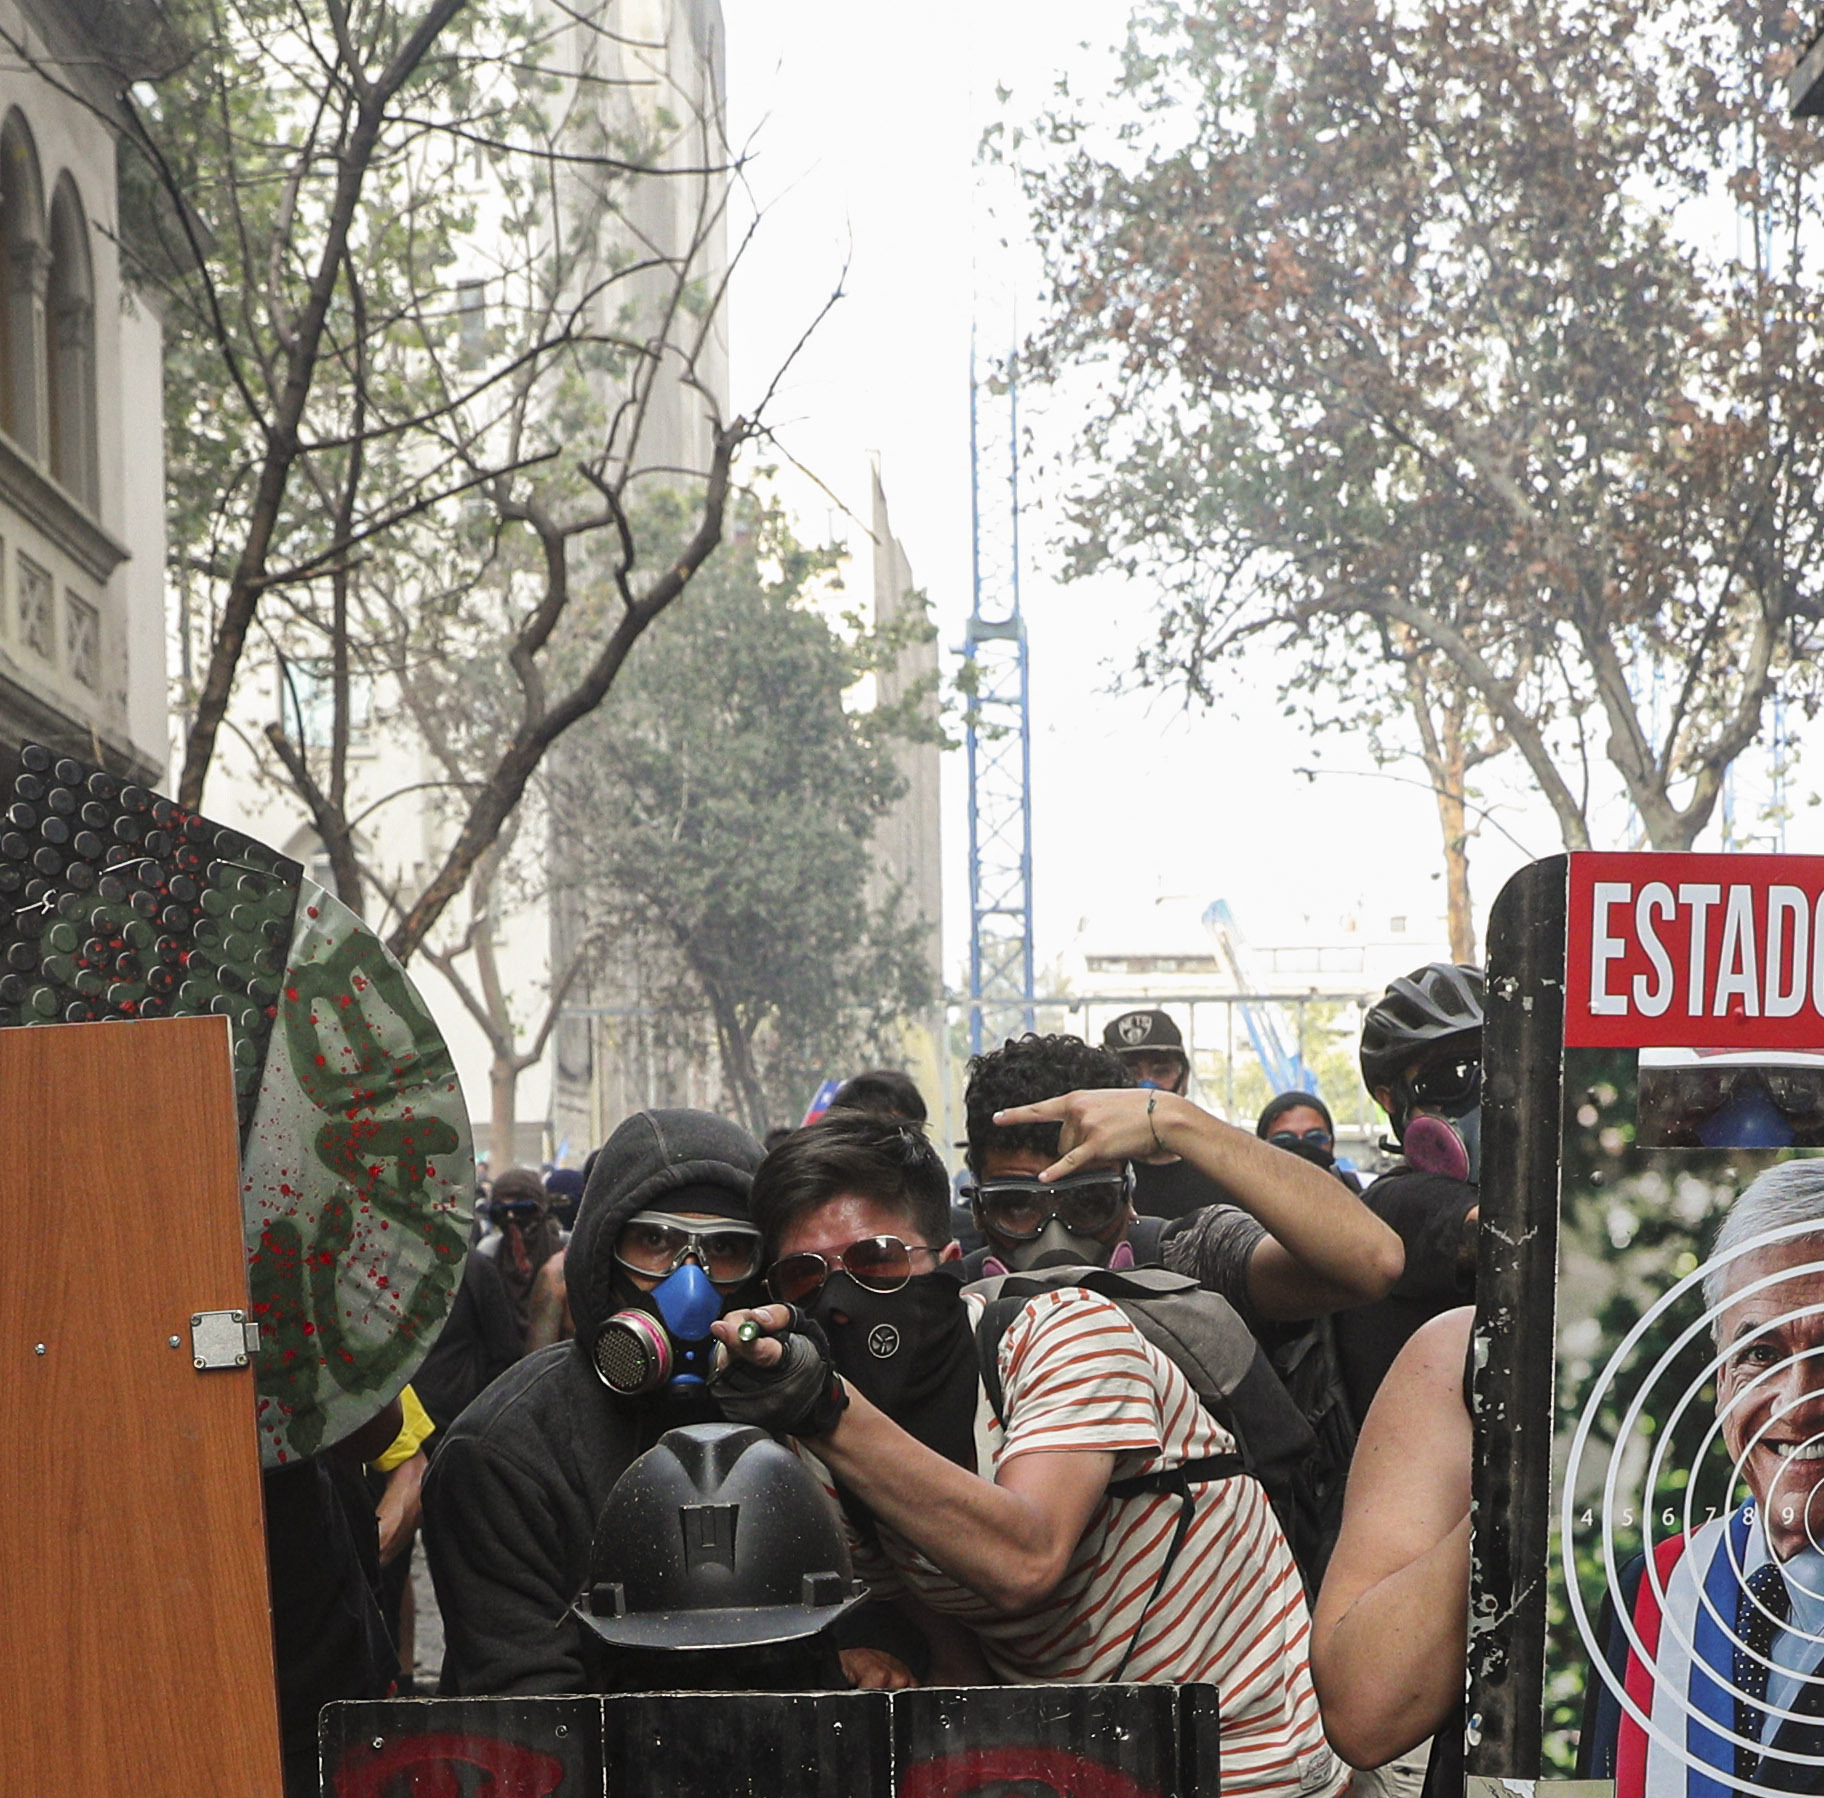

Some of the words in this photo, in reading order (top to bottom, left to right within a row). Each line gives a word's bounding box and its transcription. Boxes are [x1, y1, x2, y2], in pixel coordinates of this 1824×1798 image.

[1580, 1508, 1593, 1526] 4
[1620, 1508, 1634, 1527] 5
[1662, 1507, 1675, 1526] 6
[1703, 1507, 1717, 1526] 7
[1740, 1507, 1754, 1526] 8
[1781, 1506, 1795, 1525] 9
